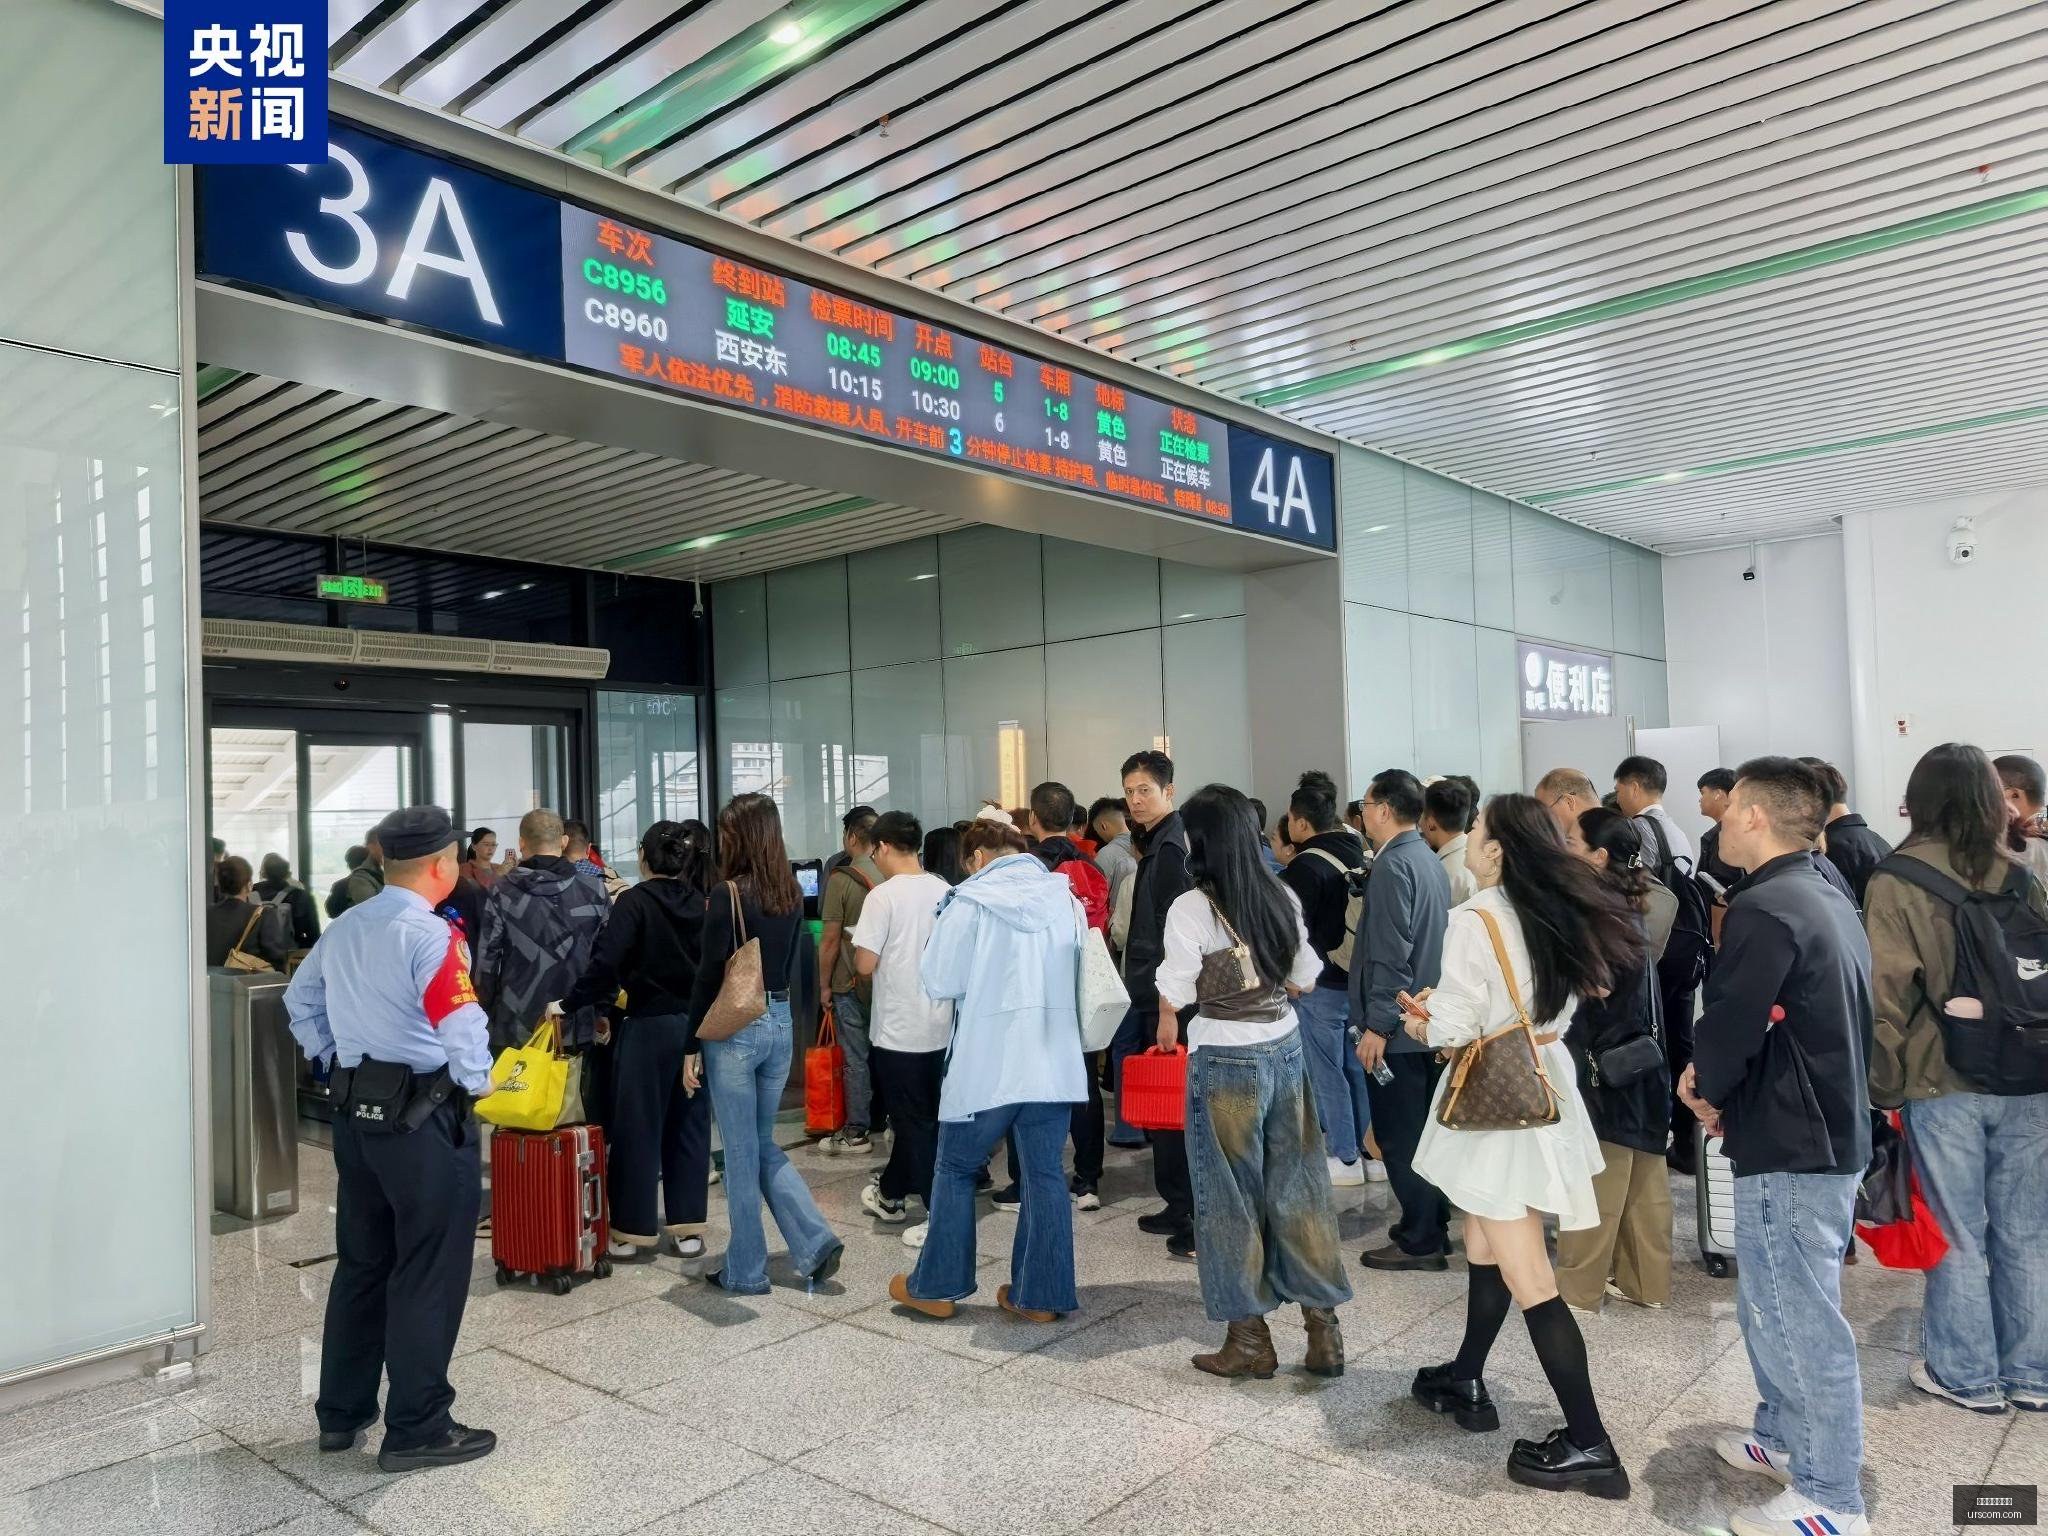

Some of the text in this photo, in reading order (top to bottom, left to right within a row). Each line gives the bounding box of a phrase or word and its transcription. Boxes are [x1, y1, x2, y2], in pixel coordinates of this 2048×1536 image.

[284, 141, 504, 327] 3A
[597, 219, 656, 269] 车次
[712, 257, 785, 308] 终到站
[810, 290, 894, 342] 检票时间
[914, 322, 953, 359] 开点
[978, 342, 1013, 378] 站台
[583, 257, 1210, 464] C8956 延安 08:45 09:00 5 1-8 黄色 正在检票
[584, 297, 1211, 490] C8960 西安东 10:15 10:30 6 1-8 黄色 正在候车
[896, 416, 945, 449] 开车前
[949, 427, 962, 455] 3
[1250, 447, 1317, 534] 4A
[1546, 659, 1611, 714] 便利店
[356, 1110, 384, 1121] POLICE
